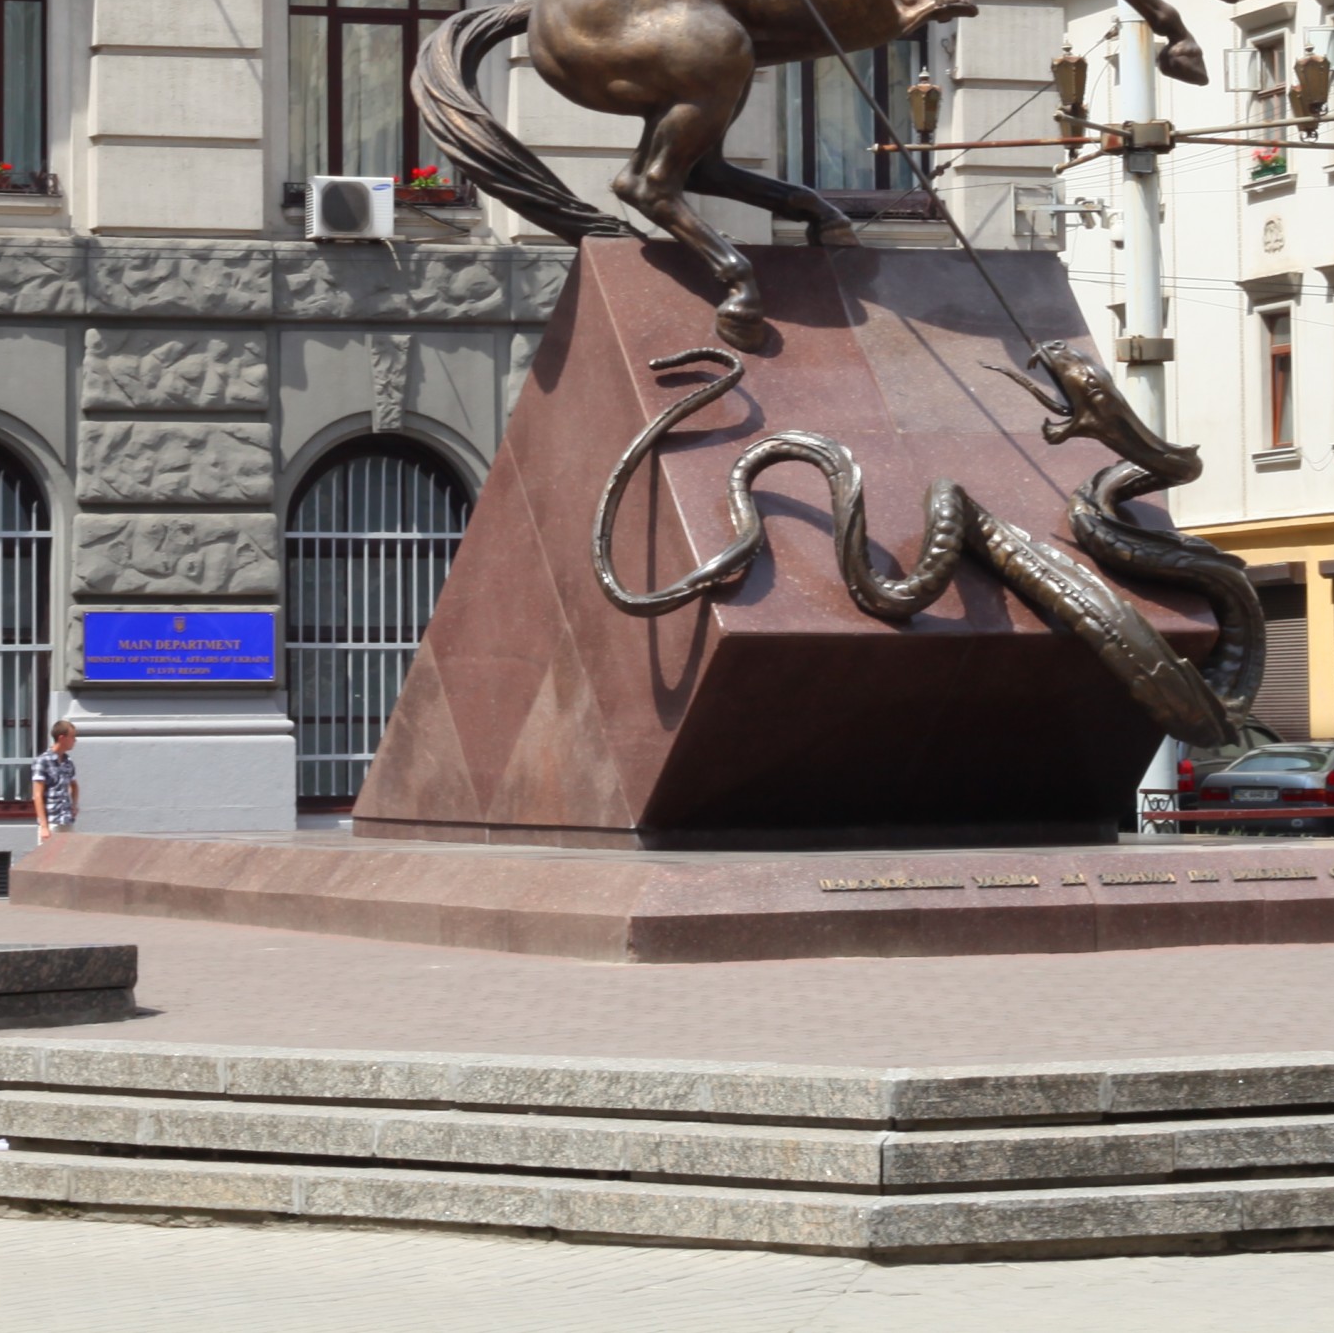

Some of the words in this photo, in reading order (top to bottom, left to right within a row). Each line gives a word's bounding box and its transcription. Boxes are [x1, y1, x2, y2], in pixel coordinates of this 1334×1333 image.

[118, 640, 152, 650] MAIN
[155, 640, 242, 650] DEPARTMENT
[87, 656, 126, 664] MINISTRY
[128, 656, 139, 664] OF
[140, 656, 182, 664] INTERNAL
[186, 656, 219, 664] AFFAIRS
[220, 656, 232, 664] OF
[233, 656, 270, 664] UKRAINE
